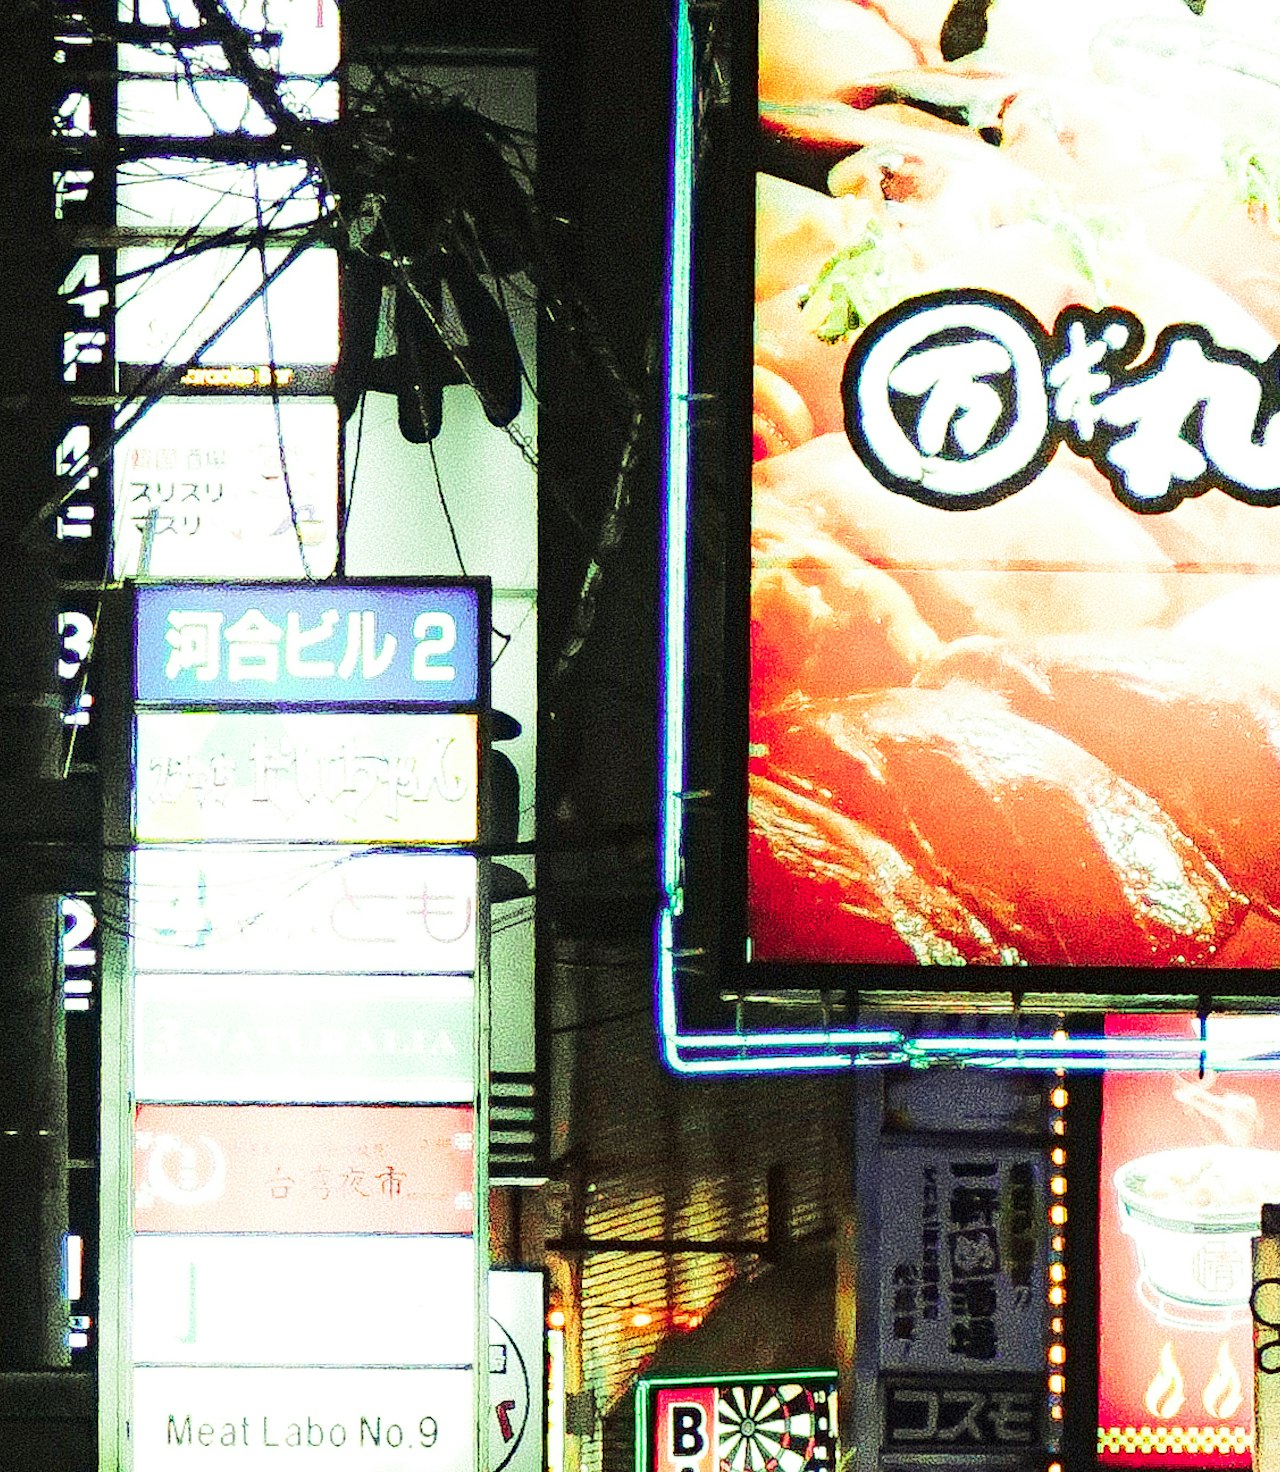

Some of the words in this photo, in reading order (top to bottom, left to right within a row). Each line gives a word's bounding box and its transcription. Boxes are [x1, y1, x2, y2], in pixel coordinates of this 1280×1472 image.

[164, 1413, 251, 1449] Meat
[261, 1413, 350, 1450] Labo
[357, 1413, 442, 1450] No.9
[889, 1386, 1037, 1445] コスモ
